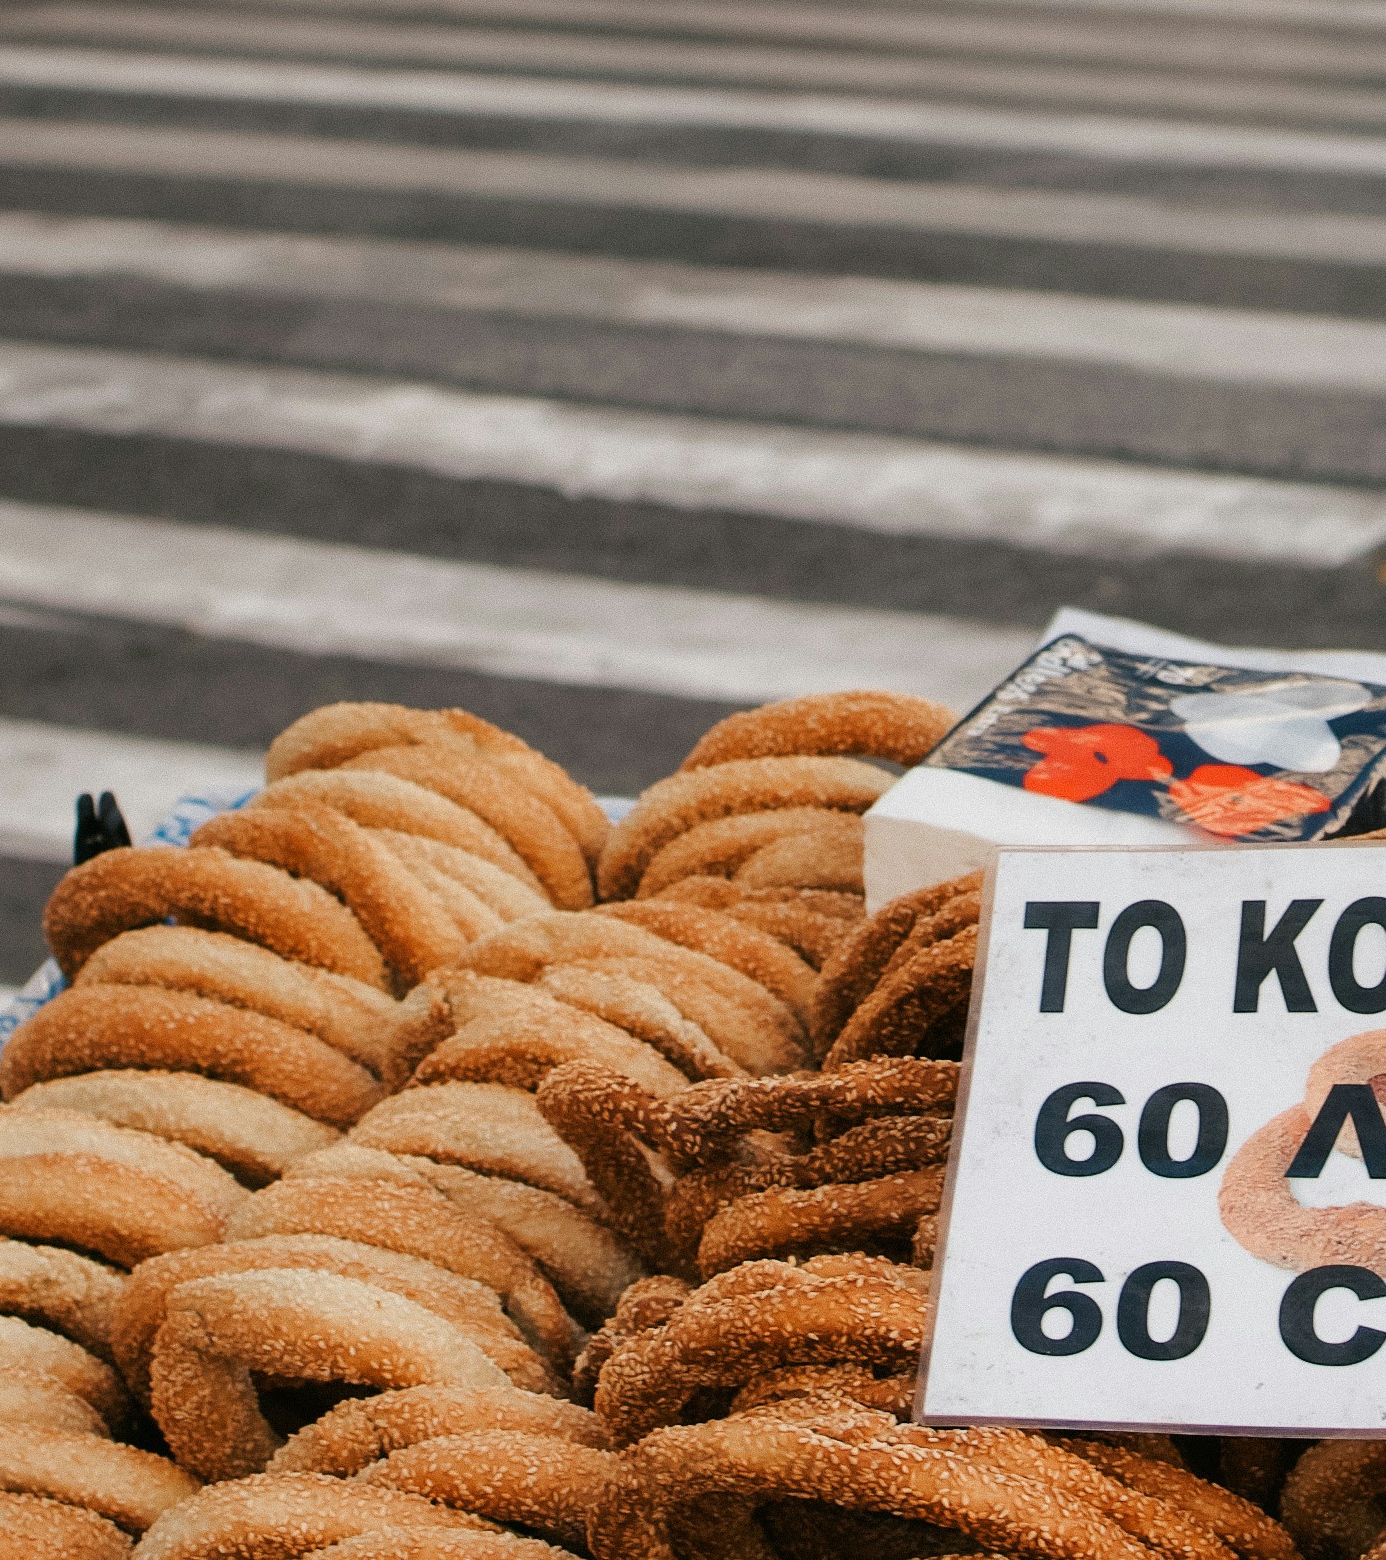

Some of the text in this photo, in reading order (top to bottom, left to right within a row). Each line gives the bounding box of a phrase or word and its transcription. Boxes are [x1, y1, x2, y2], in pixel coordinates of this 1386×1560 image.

[1024, 899, 1187, 1015] ΤΟ
[1034, 1081, 1229, 1179] 60
[1010, 1257, 1211, 1362] 60
